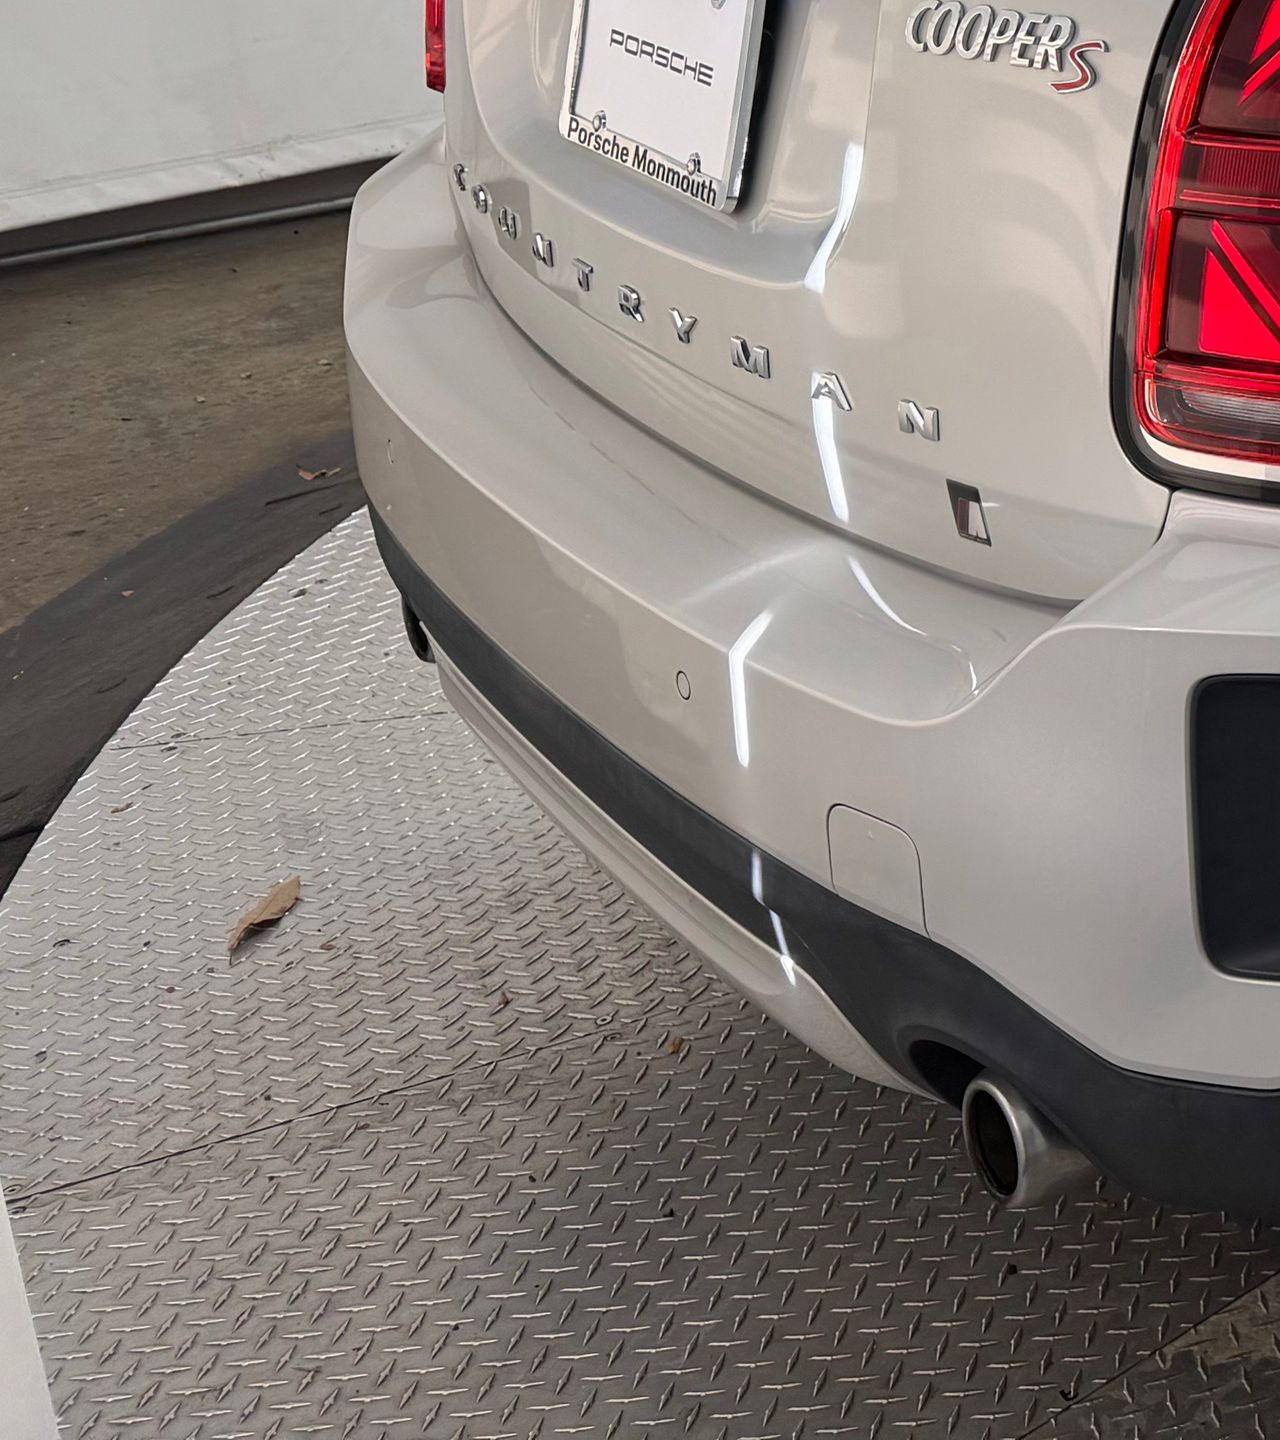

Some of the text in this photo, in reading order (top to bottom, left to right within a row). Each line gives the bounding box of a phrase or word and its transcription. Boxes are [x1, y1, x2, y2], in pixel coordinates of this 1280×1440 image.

[609, 28, 714, 87] PORSCHE
[567, 117, 718, 206] Porsche Monmouth
